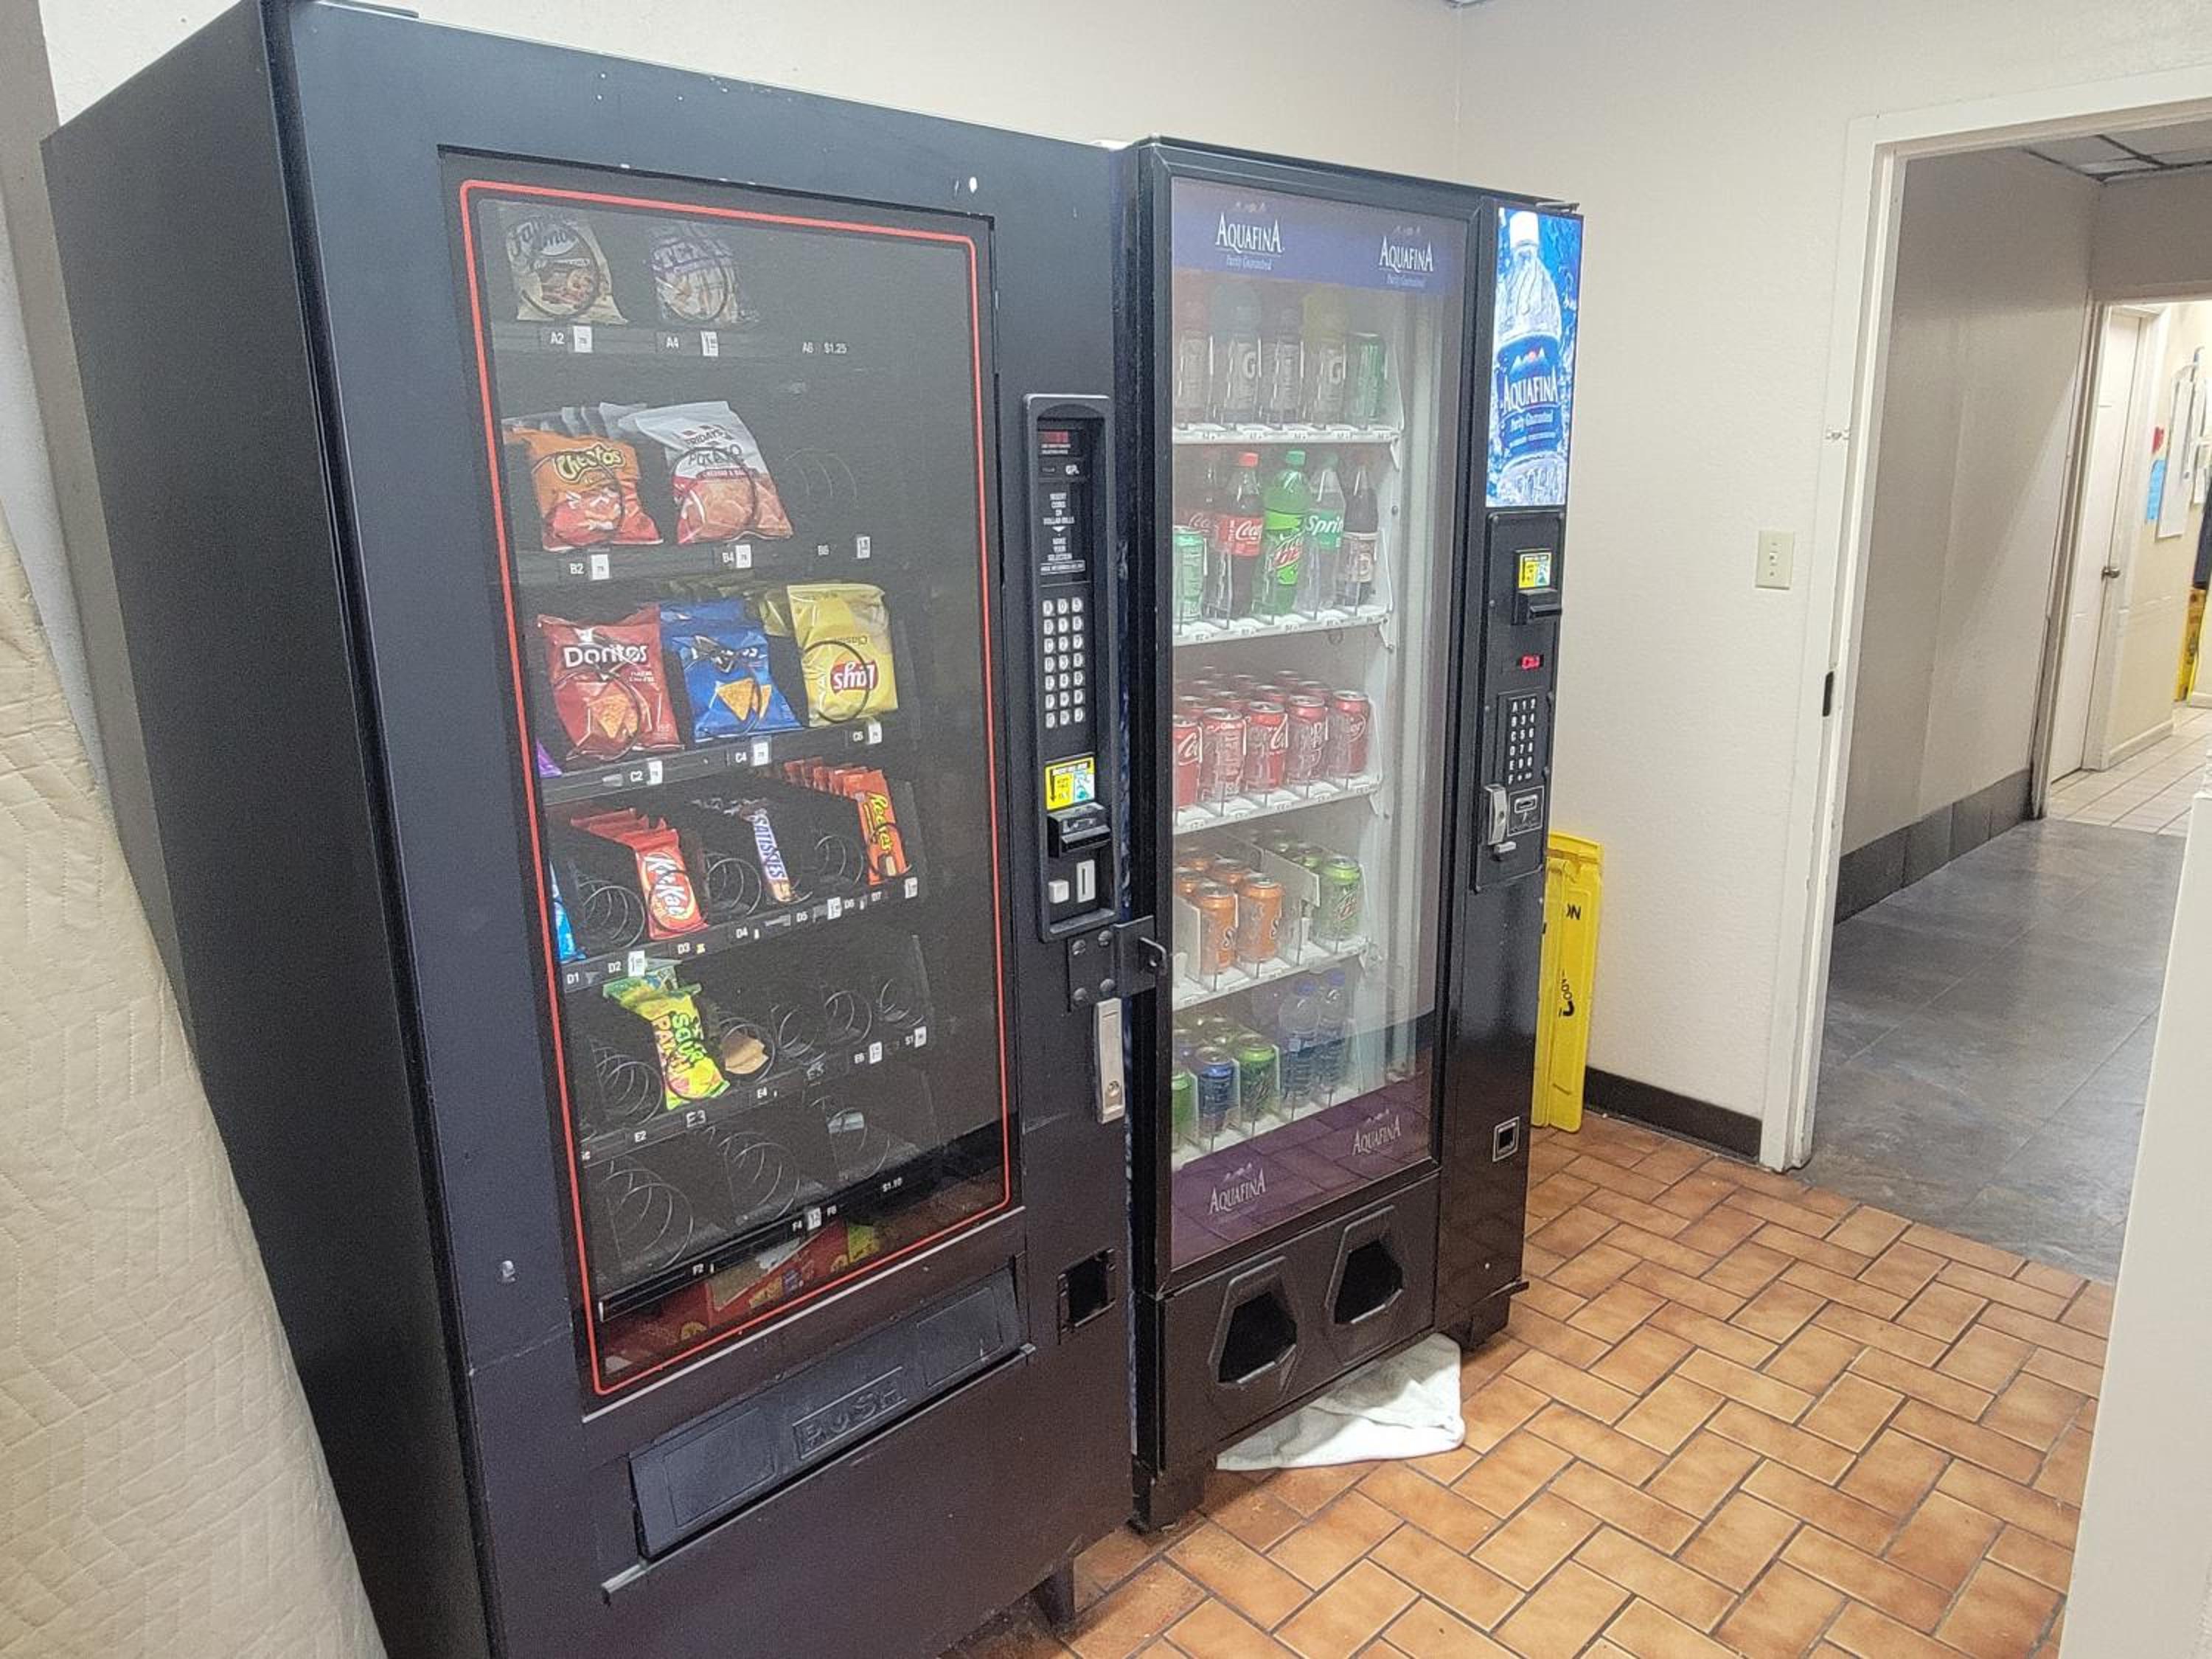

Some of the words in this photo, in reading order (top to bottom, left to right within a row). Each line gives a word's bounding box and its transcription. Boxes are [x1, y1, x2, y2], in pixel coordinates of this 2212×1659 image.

[1215, 212, 1283, 254] AQUAFINA
[1378, 235, 1434, 274] AQUAFINA
[551, 332, 564, 344] A2
[666, 337, 679, 349] A4
[824, 341, 847, 355] $1.25
[1503, 365, 1559, 414] AQUAFINA
[555, 445, 623, 479] Cheetos
[570, 563, 585, 574] B2
[563, 644, 649, 669] Doritos
[735, 752, 747, 763] C4
[630, 771, 644, 782] C2
[566, 972, 580, 984] D1
[608, 961, 622, 973] D2
[677, 943, 690, 954] D3
[736, 927, 748, 939] D4
[796, 911, 808, 922] D5
[634, 1130, 647, 1142] E2
[686, 1110, 706, 1127] E3
[1352, 1114, 1402, 1156] AQUAFINA
[1208, 1167, 1267, 1216] AQUAFINA
[801, 1387, 903, 1447] PUSH
